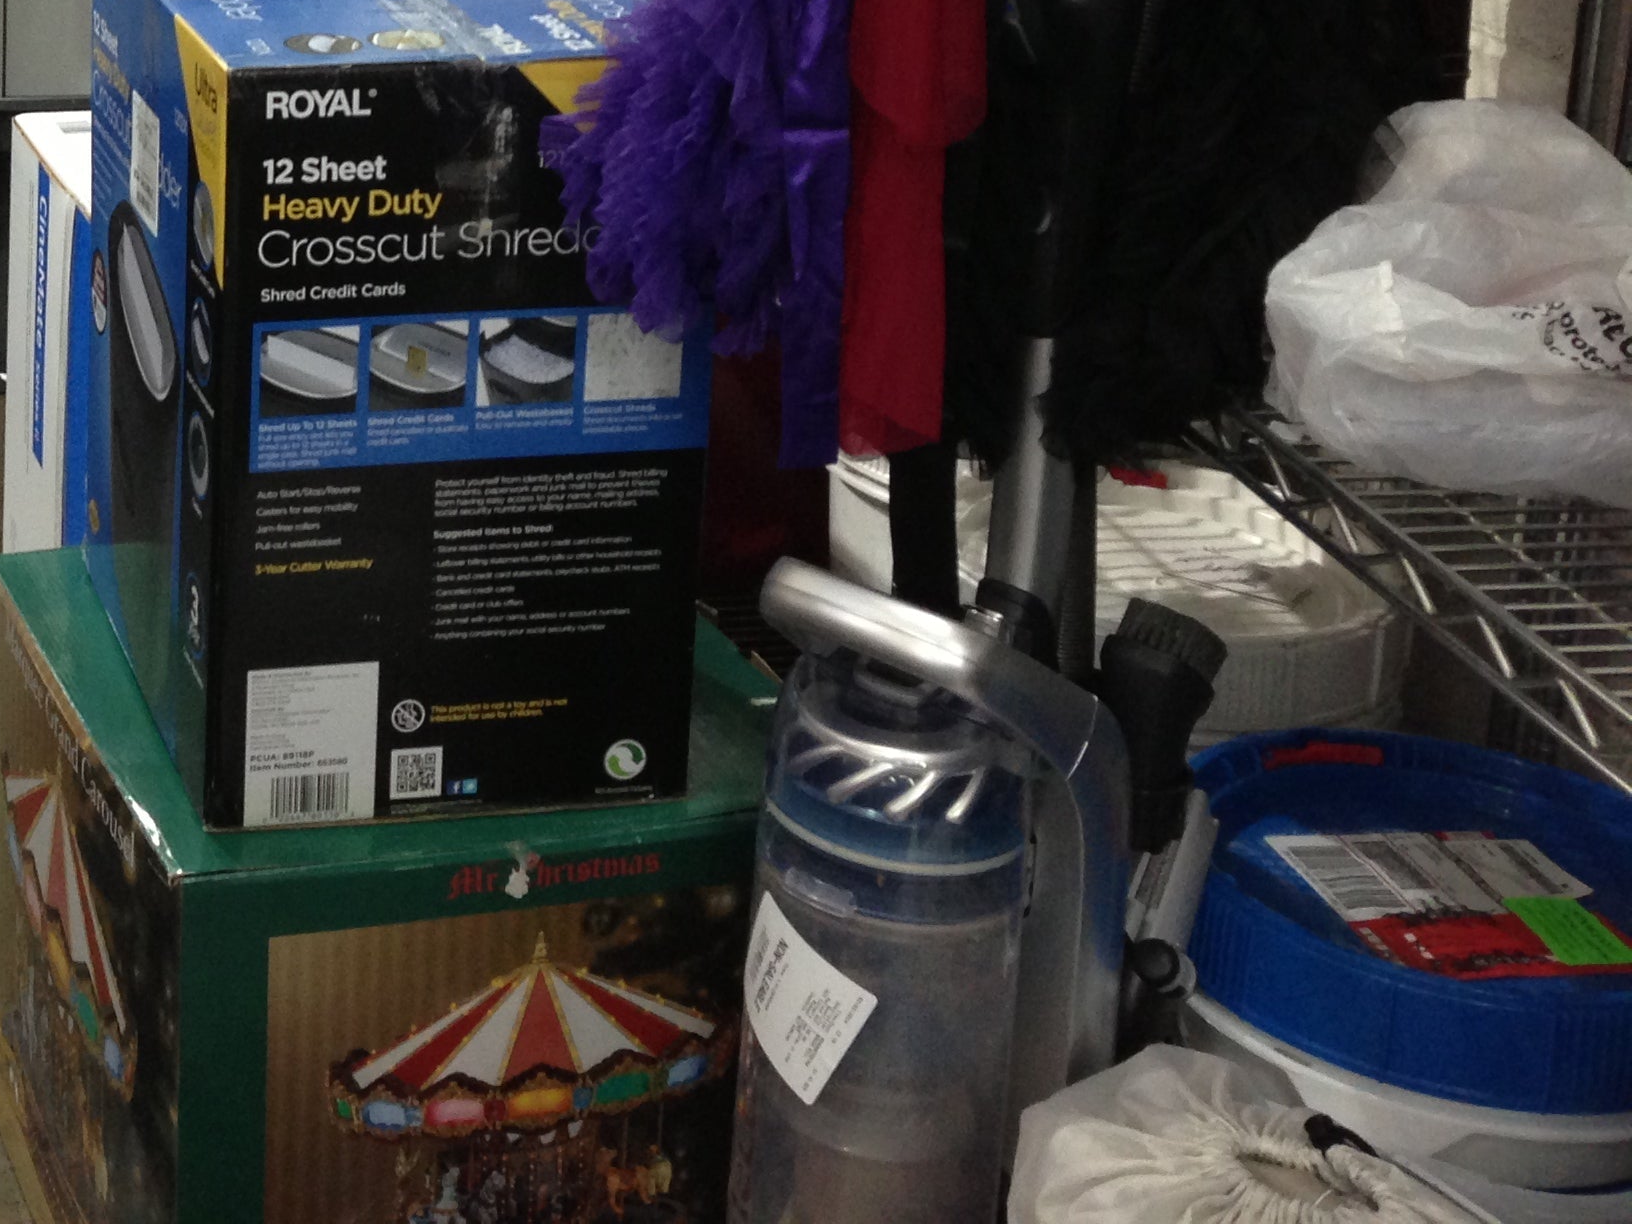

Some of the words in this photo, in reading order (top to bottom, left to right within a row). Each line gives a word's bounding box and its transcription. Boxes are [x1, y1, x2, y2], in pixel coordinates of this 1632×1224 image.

[194, 61, 218, 115] Ultra
[263, 158, 294, 185] 12
[301, 155, 388, 183] Sheet
[263, 192, 360, 223] Heavy
[367, 187, 443, 219] Duty
[258, 225, 446, 269] Crosscut
[457, 217, 602, 259] Shred
[260, 285, 306, 303] Shred
[309, 283, 358, 301] Credit
[361, 281, 406, 298] Cards
[432, 527, 483, 539] Suggested
[323, 556, 374, 571] Warranty
[81, 756, 136, 873] Carousel
